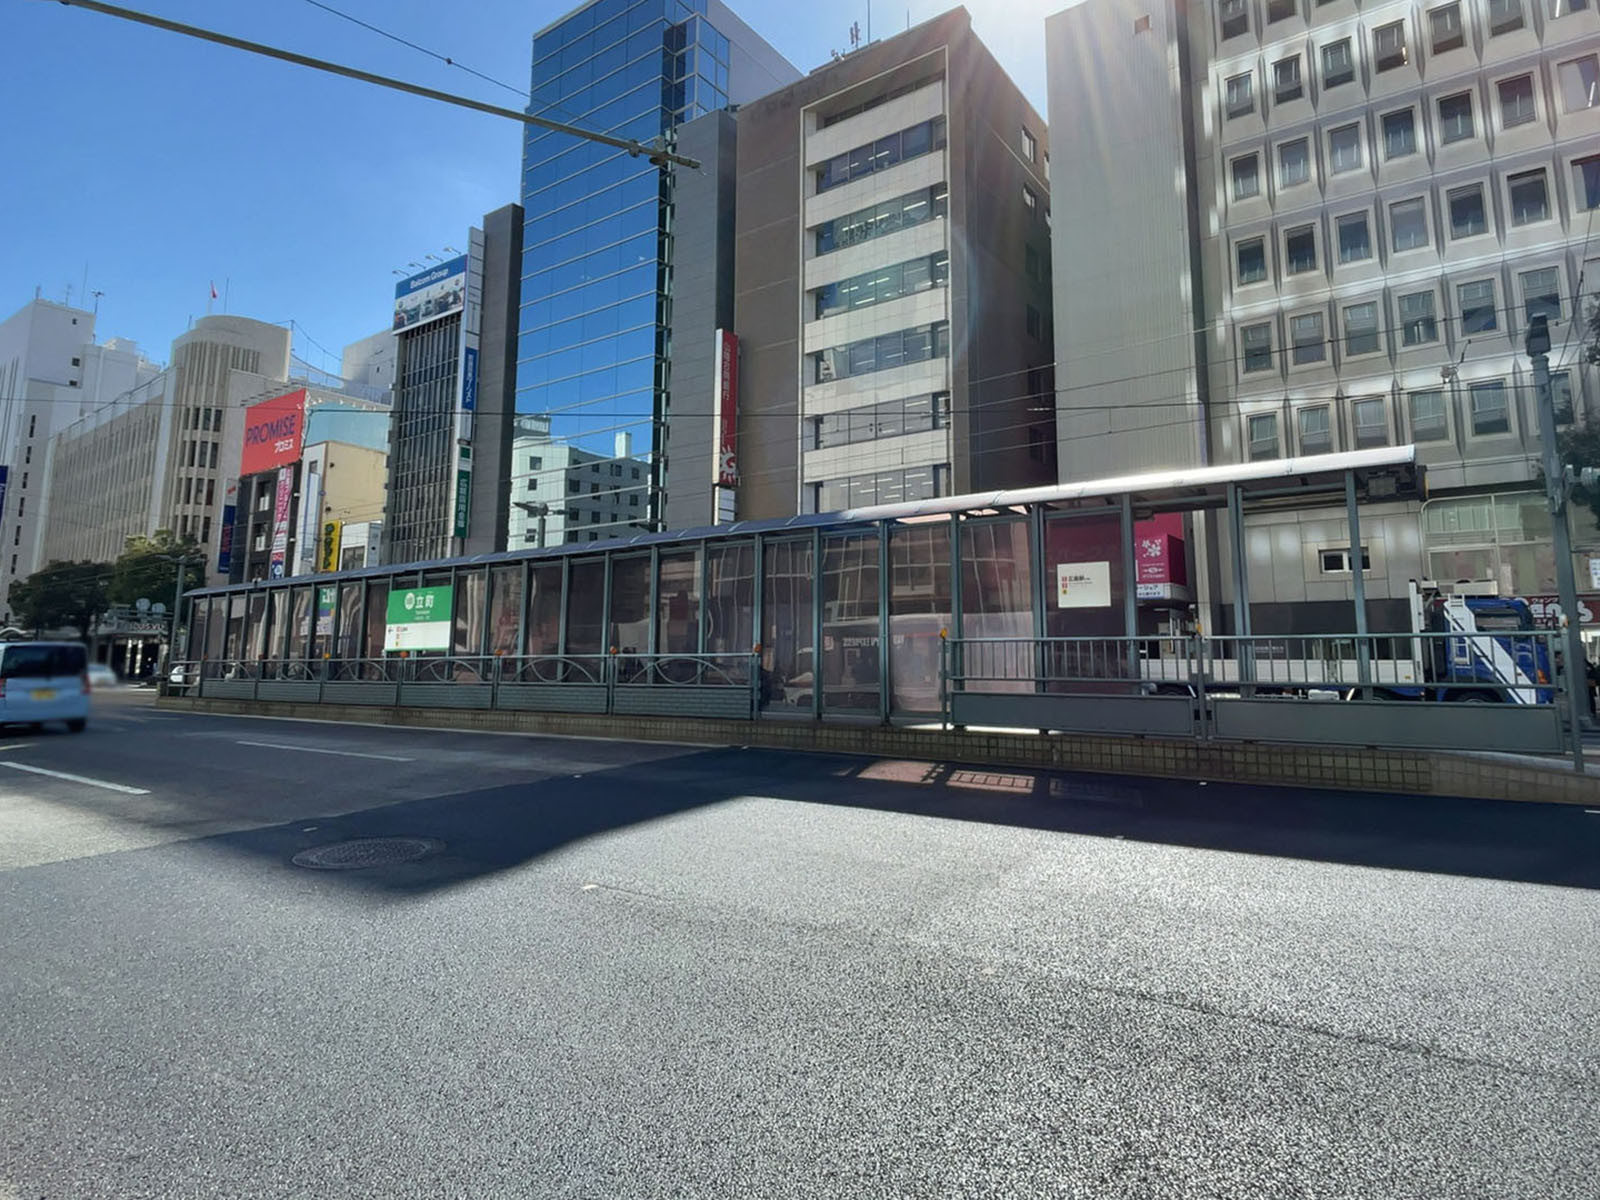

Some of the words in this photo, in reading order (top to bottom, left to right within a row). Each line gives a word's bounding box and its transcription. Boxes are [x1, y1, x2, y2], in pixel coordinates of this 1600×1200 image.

[246, 414, 297, 446] PROMISE
[274, 439, 294, 453] プロミス
[415, 594, 435, 609] 立町
